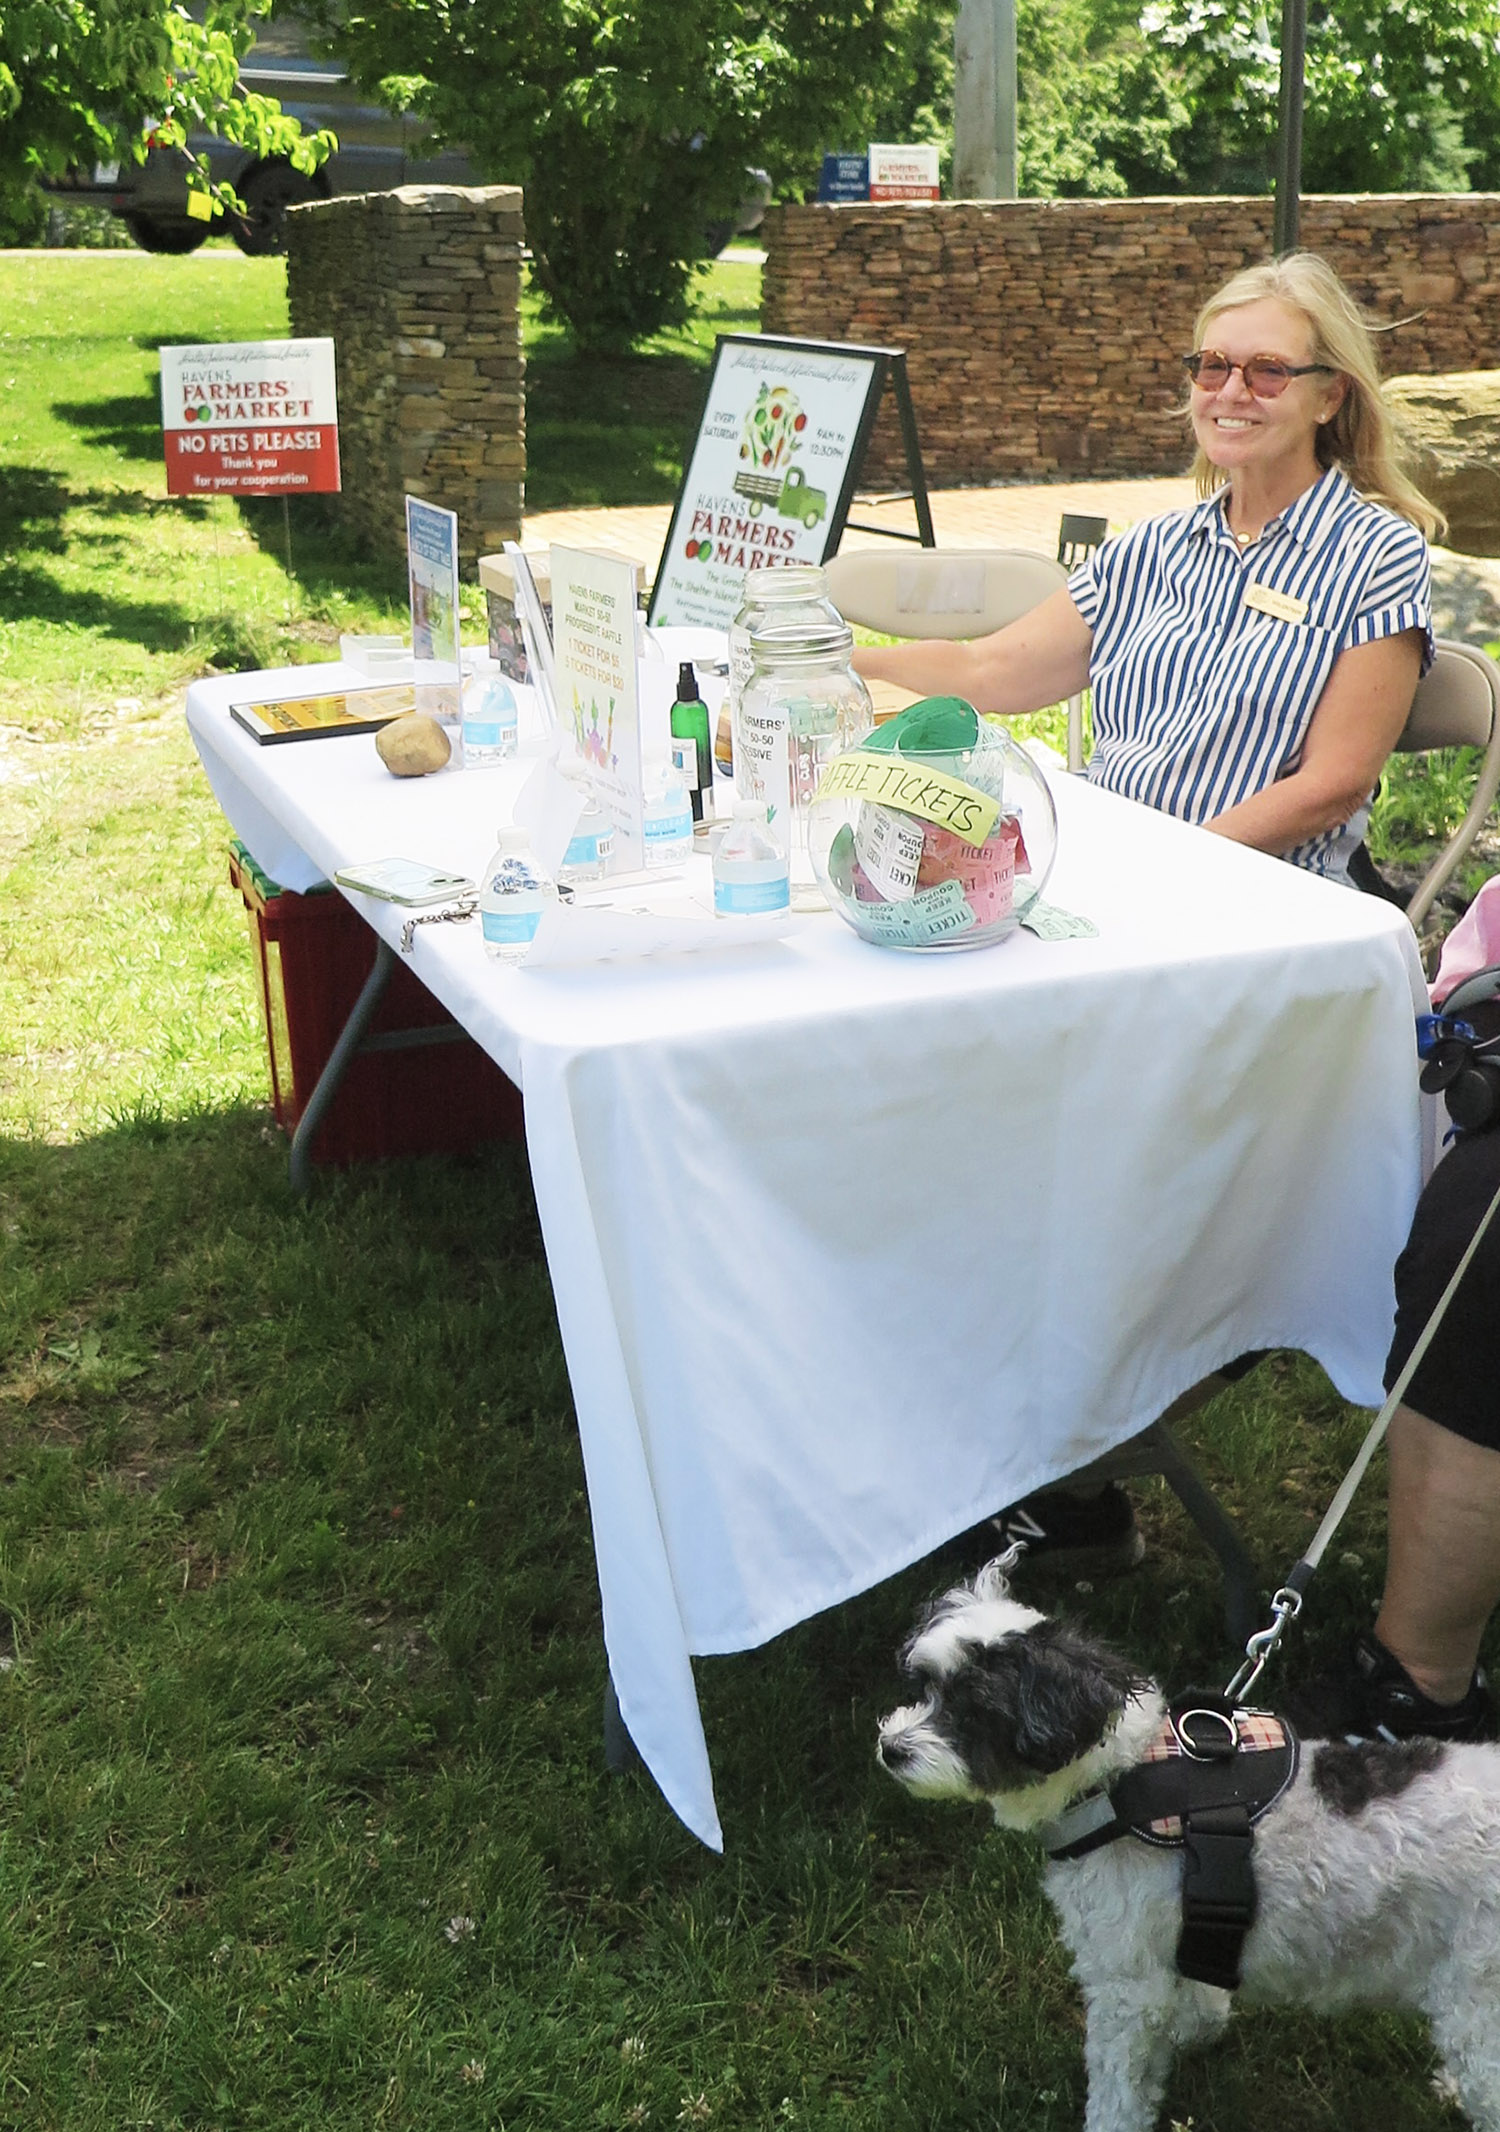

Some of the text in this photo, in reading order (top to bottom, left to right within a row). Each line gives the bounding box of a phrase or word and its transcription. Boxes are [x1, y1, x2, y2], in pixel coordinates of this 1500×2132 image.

[182, 369, 233, 382] HAVENS
[215, 400, 314, 420] MARKET
[179, 431, 321, 453] NO PETS PLEASE!
[222, 456, 277, 471] Thank you
[194, 472, 308, 489] for your cooperation
[697, 493, 747, 517] HAVENS
[573, 638, 595, 659] TICKET
[597, 646, 611, 664] FOR
[598, 668, 611, 687] FOR
[750, 732, 774, 746] 50-50
[819, 762, 879, 794] AFFLE
[886, 766, 983, 832] TICKETS
[898, 832, 922, 848] OUPON
[961, 846, 993, 860] TICKET
[889, 866, 916, 887] ICKET
[913, 884, 953, 906] COUPON
[925, 896, 952, 913] KEEP
[929, 911, 968, 934] TICKET
